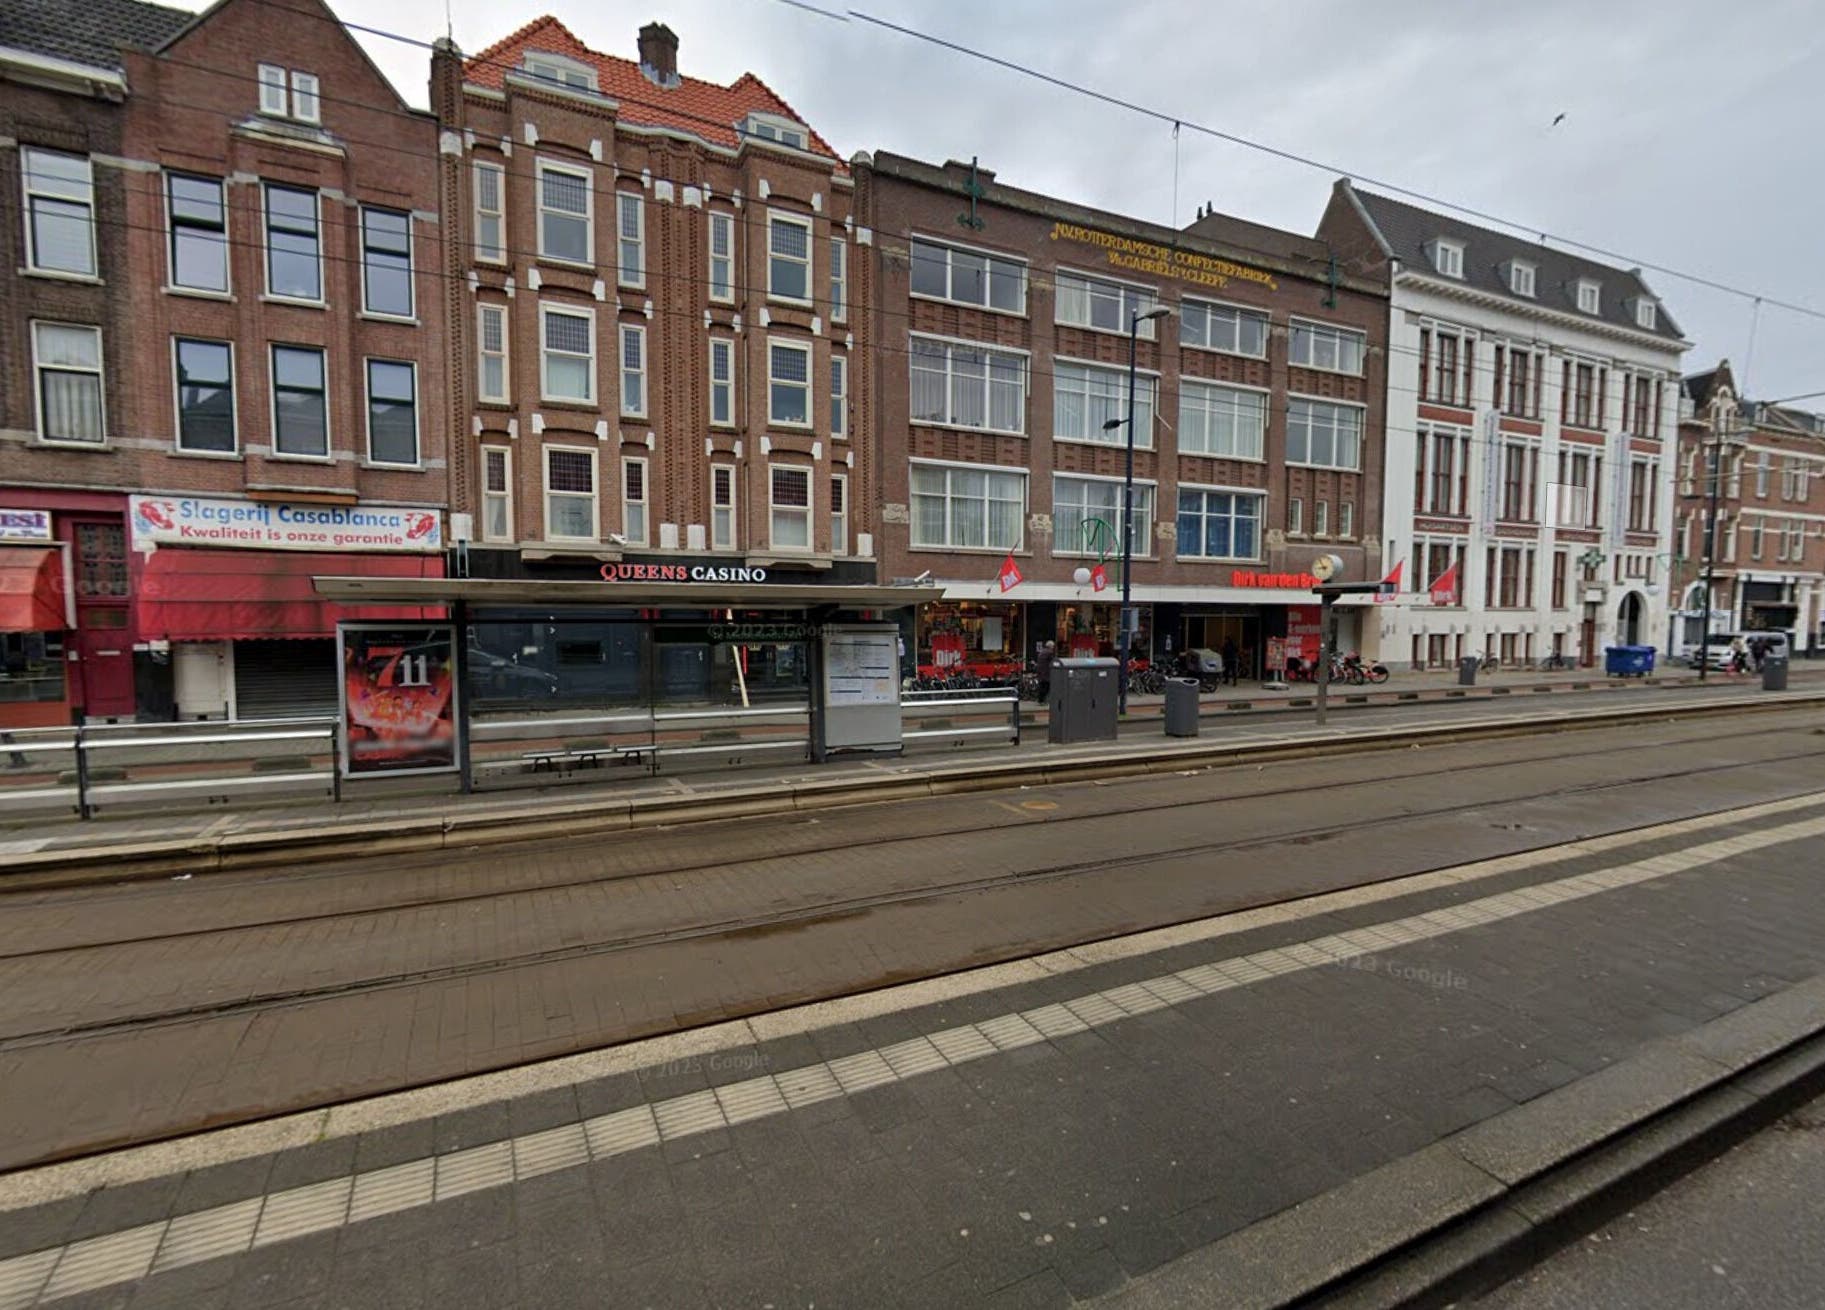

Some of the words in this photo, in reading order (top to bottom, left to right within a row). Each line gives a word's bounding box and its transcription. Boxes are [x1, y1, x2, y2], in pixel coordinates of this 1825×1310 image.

[180, 501, 270, 526] Slagerij
[278, 504, 400, 527] Casablanca
[180, 525, 262, 540] Kwaliteit
[267, 529, 281, 540] is
[287, 531, 328, 542] onze
[333, 532, 403, 546] garantie
[600, 563, 688, 582] QUEENS
[691, 565, 767, 582] CASINO
